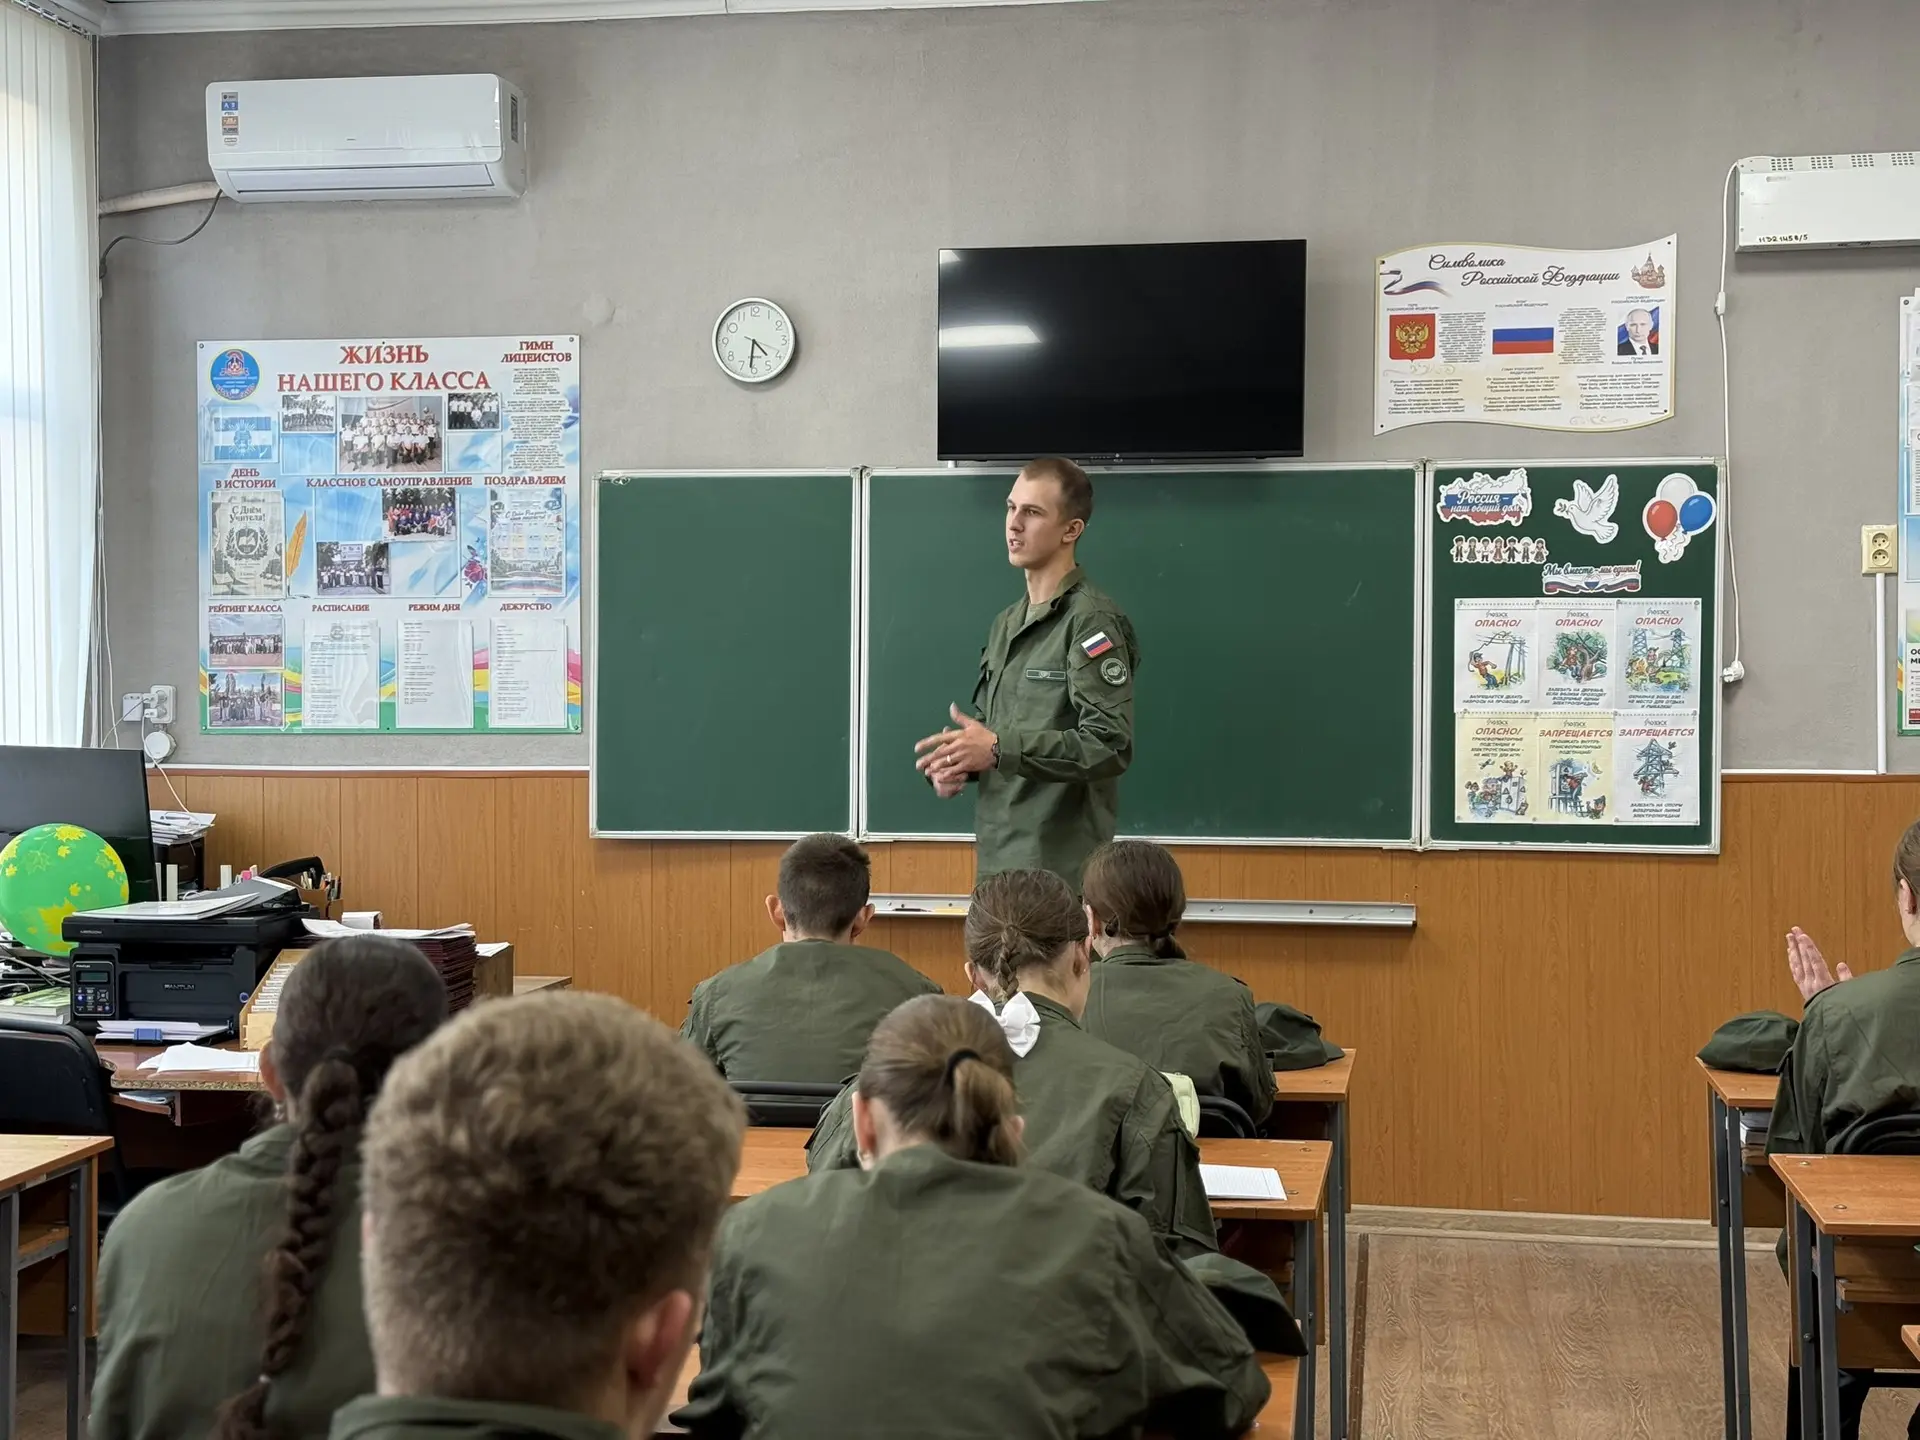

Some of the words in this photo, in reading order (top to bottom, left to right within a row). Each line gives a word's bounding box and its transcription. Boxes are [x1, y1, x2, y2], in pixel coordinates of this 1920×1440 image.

[1428, 252, 1506, 270] Символика
[1461, 271, 1539, 287] Российской
[1542, 265, 1620, 287] Федерации
[738, 311, 745, 322] 11
[751, 306, 760, 318] 12
[727, 322, 738, 334] 10
[775, 320, 783, 331] 2
[519, 341, 554, 351] ГИМН
[722, 336, 729, 348] 9
[781, 335, 788, 346] 3
[339, 344, 429, 364] ЖИЗНЬ
[500, 353, 573, 364] ЛИЦЕИСТОВ
[727, 350, 734, 361] 8
[775, 350, 783, 360] 4
[738, 360, 745, 371] 7
[751, 364, 758, 375] 6
[764, 361, 771, 371] 5
[277, 372, 384, 392] НАШЕГО
[390, 371, 492, 391] КЛАССА
[231, 468, 260, 480] ДЕНЬ
[225, 480, 276, 488] ИСТОРИИ
[306, 478, 367, 487] КЛАССНОЕ
[368, 477, 472, 487] САМОУПРАВЛЕНИЕ
[484, 476, 566, 487] ПОЗДРАВЛЯЕМ
[1457, 490, 1501, 504] Россия
[1450, 505, 1469, 513] наш
[1471, 504, 1499, 515] общий
[1501, 505, 1520, 516] дом
[1544, 564, 1562, 576] Мы
[1564, 563, 1593, 575] вместе
[208, 604, 247, 613] РЕЙТИНГ
[248, 604, 283, 612] КЛАССА
[312, 604, 370, 612] РАСПИСАНИЕ
[408, 604, 441, 612] РЕЖИМ
[442, 604, 461, 612] ДНЯ
[499, 603, 552, 612] ДЕЖУРСТВО
[1475, 619, 1522, 627] ОПАСНО!
[1555, 619, 1603, 627] ОПАСНО!
[1635, 617, 1684, 625] ОПАСНО!
[1475, 727, 1522, 735] ОПАСНО!
[1539, 730, 1613, 738] ЗАПРЕЩАЕТСЯ
[1619, 729, 1695, 737] ЗАПРЕЩАЕТСЯ
